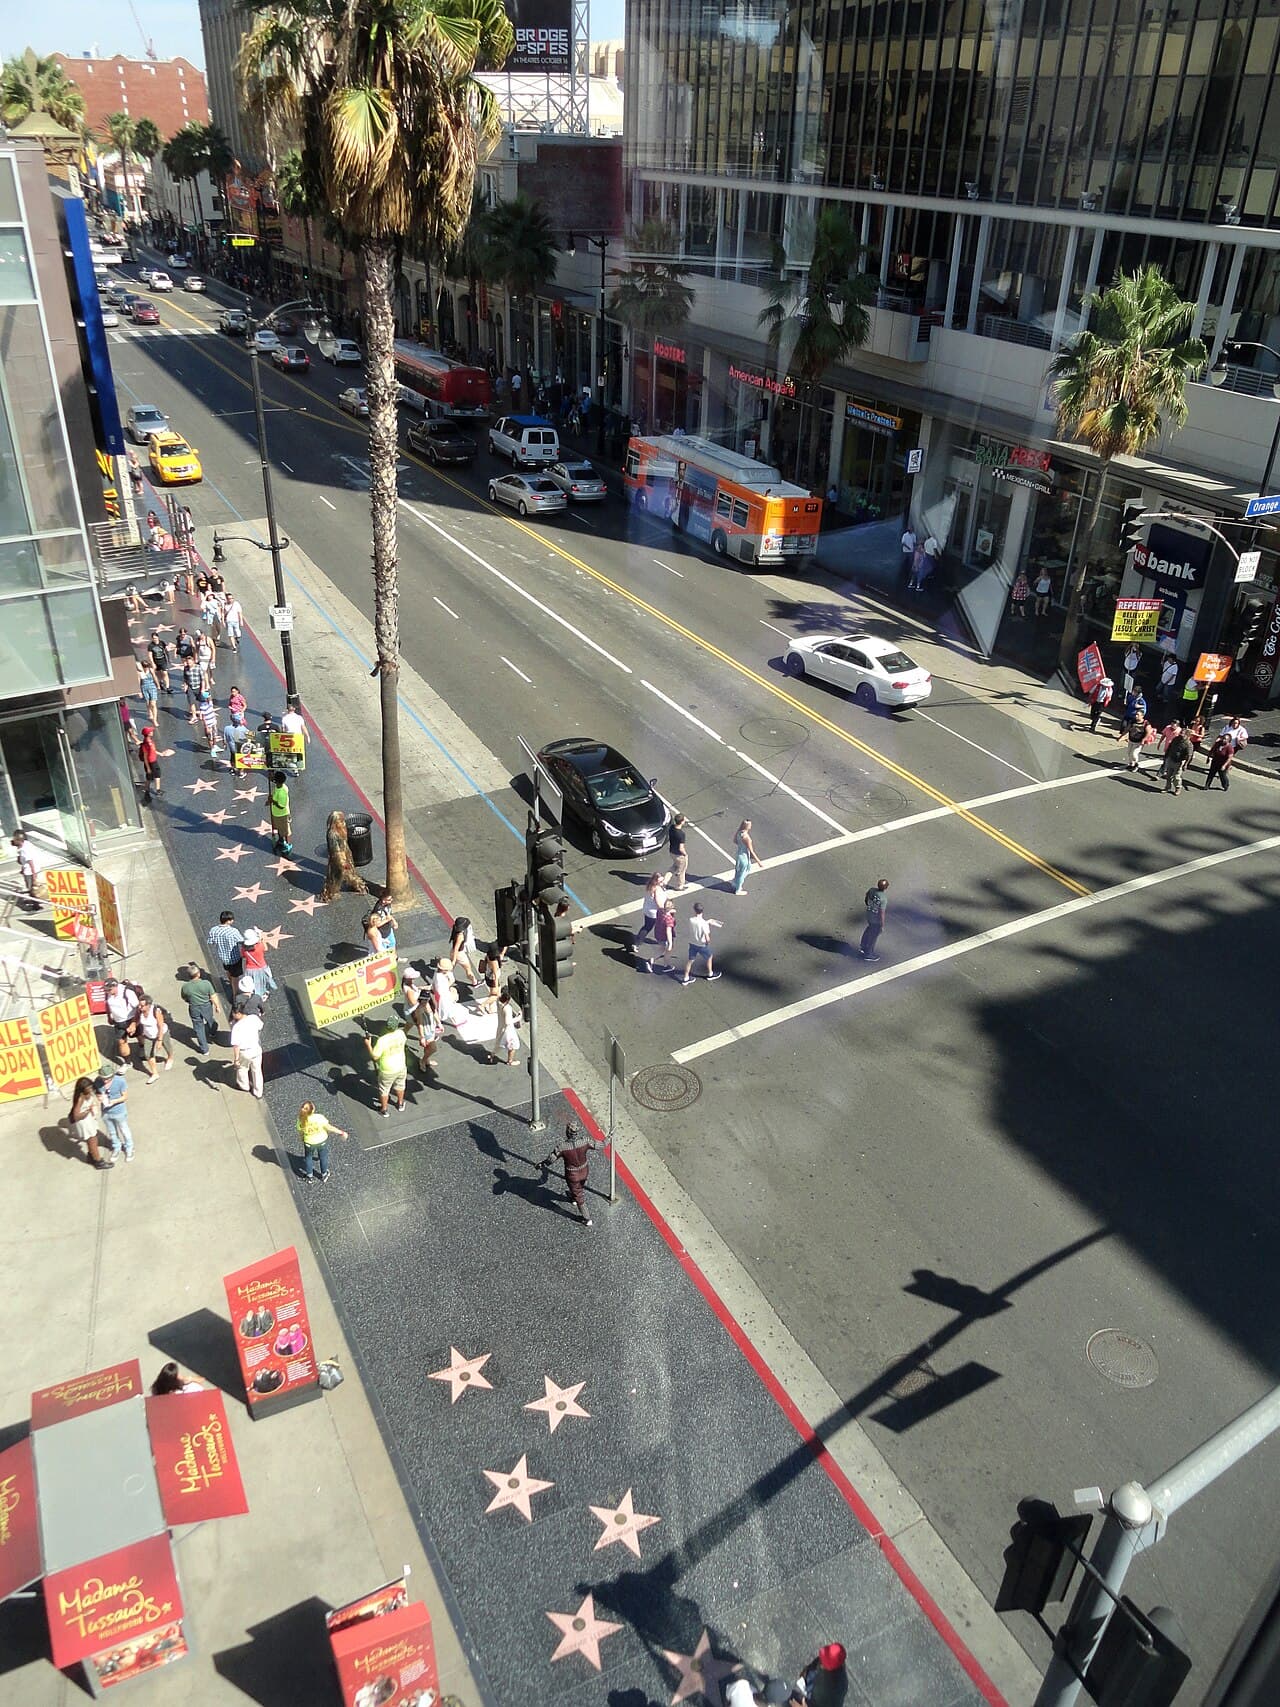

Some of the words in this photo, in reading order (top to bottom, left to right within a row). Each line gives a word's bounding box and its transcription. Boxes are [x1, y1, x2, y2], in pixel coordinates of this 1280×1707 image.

[516, 28, 568, 41] BRIDGE
[527, 42, 568, 55] SPIES
[728, 365, 764, 387] American
[765, 377, 796, 398] Apparel
[975, 443, 1009, 466] BAJA
[1010, 446, 1053, 472] FRESH
[1253, 500, 1279, 513] Orange
[1114, 625, 1132, 633] JESUS
[1134, 625, 1156, 633] CHRIST
[46, 871, 88, 894] SALE
[307, 954, 383, 986] EVERYTHING
[40, 996, 91, 1036] SALE
[0, 1019, 32, 1047] ALE
[47, 1023, 92, 1058] TODAY
[0, 1047, 36, 1076] ODAY
[53, 1047, 100, 1084] ONLY!
[175, 1432, 202, 1494] Madame
[192, 1421, 223, 1488] Tussauds
[58, 1575, 144, 1617] Madame
[65, 1589, 162, 1638] Tussauds
